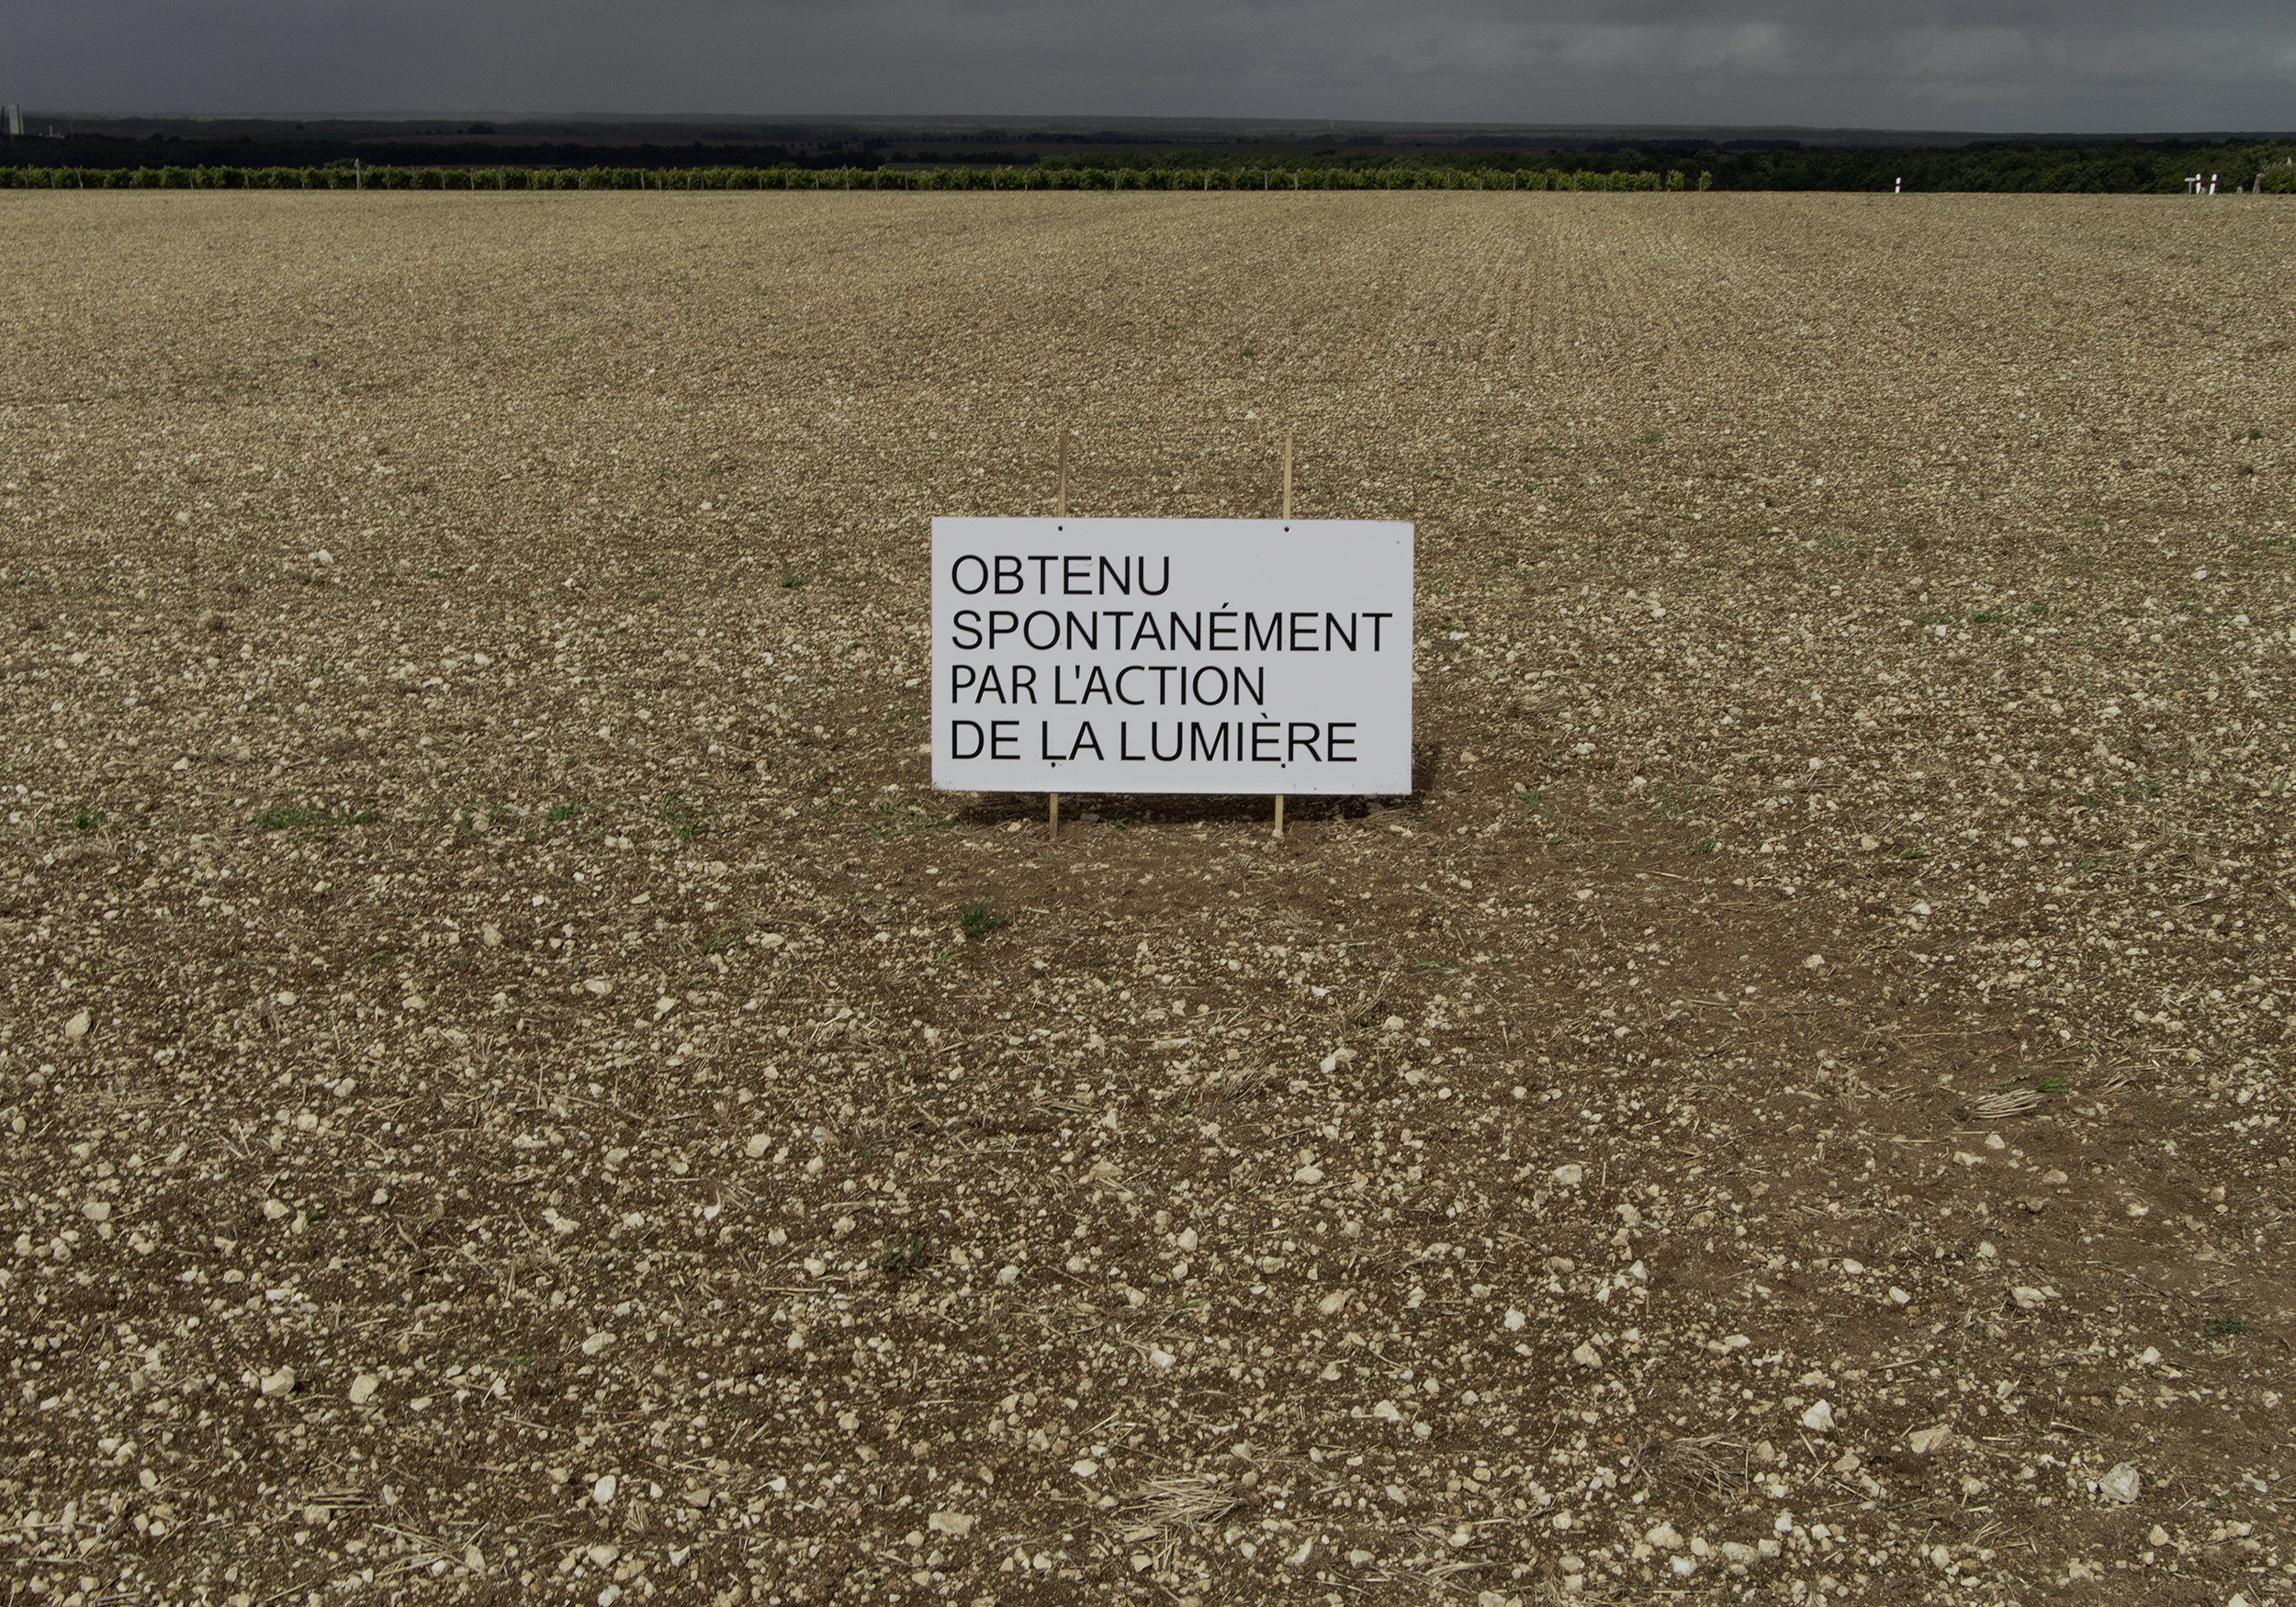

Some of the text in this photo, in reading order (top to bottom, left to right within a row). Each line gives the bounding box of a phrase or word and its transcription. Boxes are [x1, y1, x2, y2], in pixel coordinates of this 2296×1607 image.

[951, 554, 1170, 596] OBTENU
[951, 601, 1393, 652] SPONTANÉMENT
[951, 664, 1265, 706] PAR L'ACTION
[951, 712, 1357, 762] DE LA LUMIÈRE
